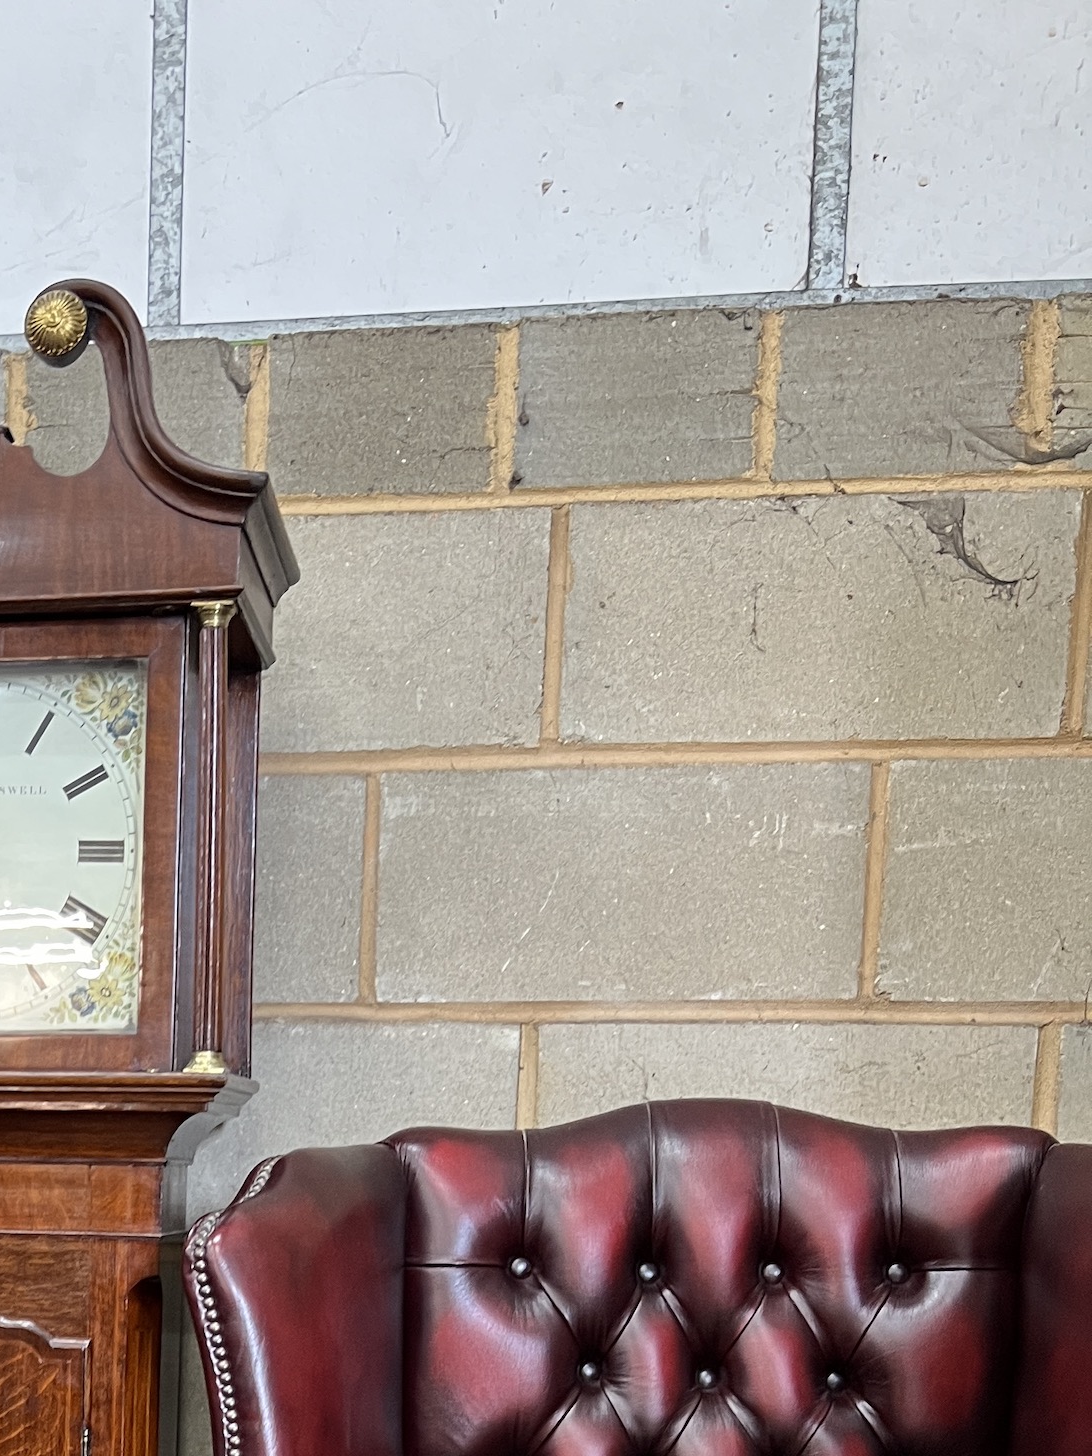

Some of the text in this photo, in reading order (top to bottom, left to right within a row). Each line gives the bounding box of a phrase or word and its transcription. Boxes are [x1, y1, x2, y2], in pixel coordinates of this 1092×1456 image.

[24, 710, 55, 756] I
[62, 763, 109, 801] II
[76, 838, 125, 865] III
